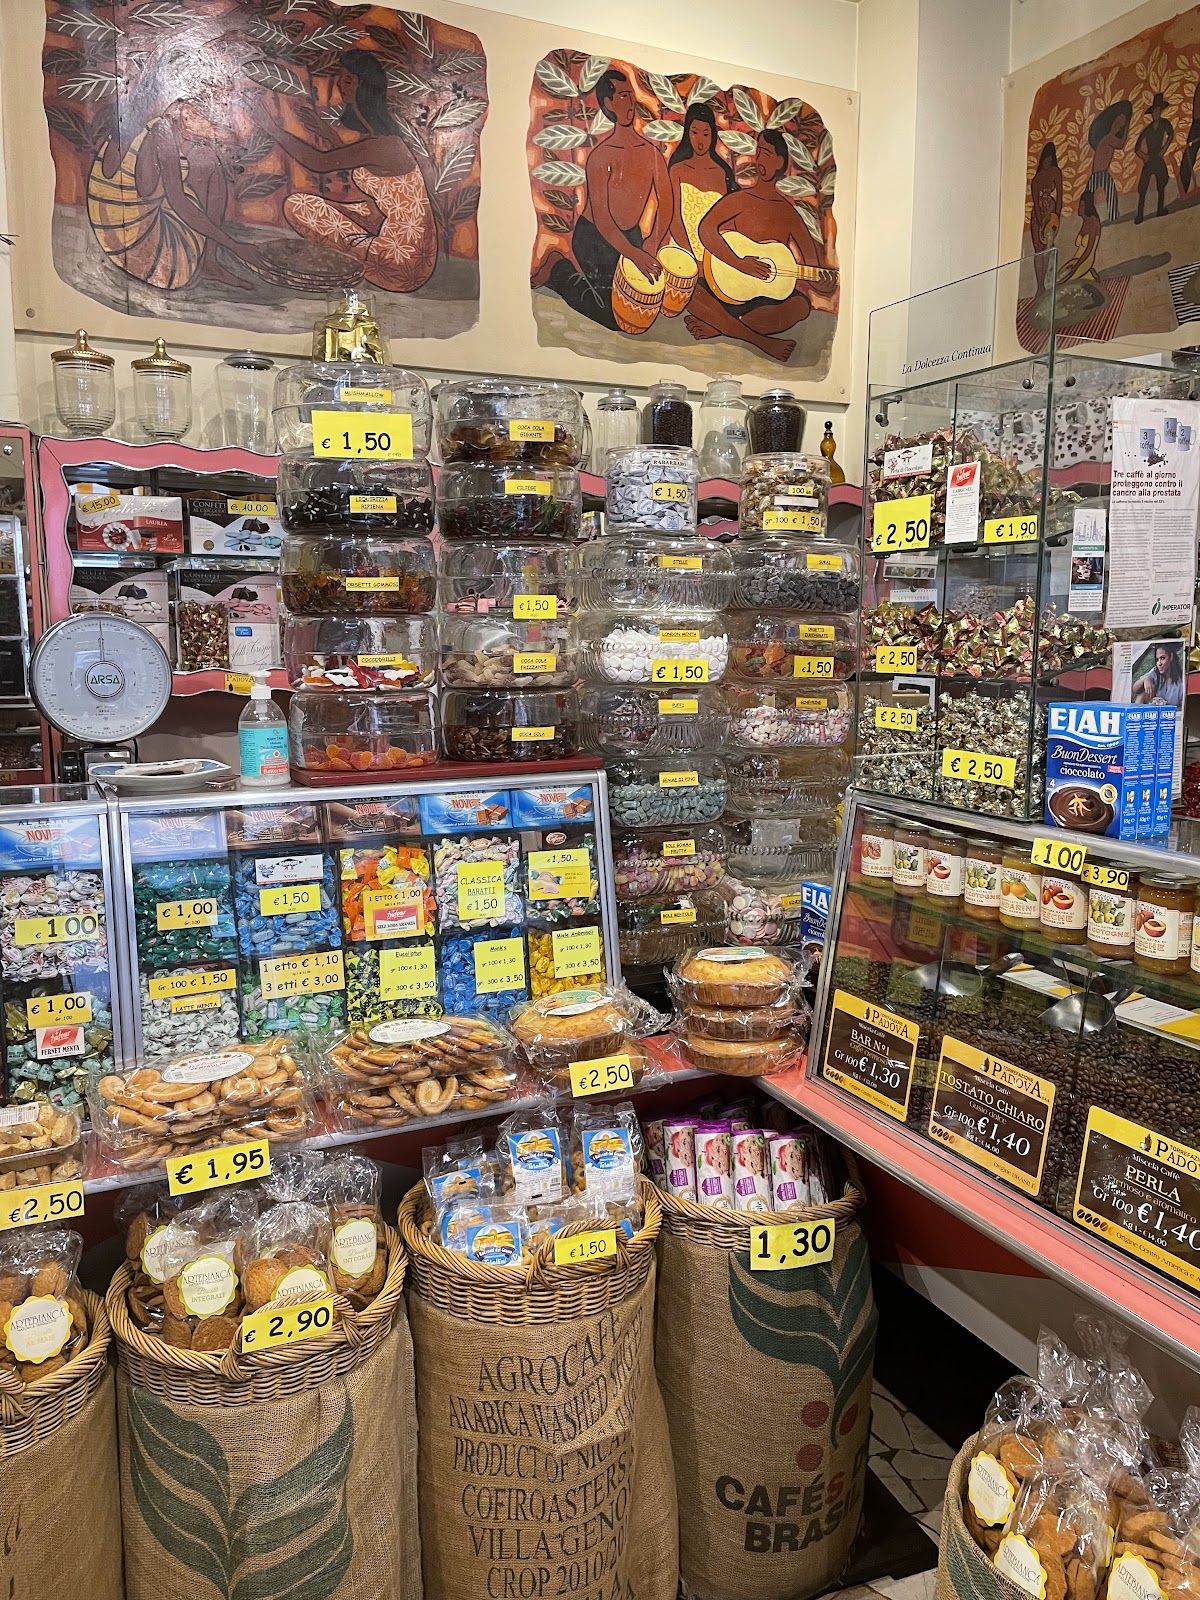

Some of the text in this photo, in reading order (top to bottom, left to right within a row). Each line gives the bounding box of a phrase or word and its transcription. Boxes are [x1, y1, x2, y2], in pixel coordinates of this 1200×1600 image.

[902, 343, 991, 375] La Dolcezza Continua
[321, 431, 391, 454] € 1,50
[1143, 431, 1148, 440] 3
[1112, 480, 1177, 489] proteggono contro
[1113, 470, 1177, 480] Tre caffè al giorno
[654, 487, 687, 500] € 1,50
[1112, 489, 1182, 498] cancro alla prostata
[145, 519, 168, 527] LAUREA
[996, 521, 1036, 539] € 1,90
[876, 534, 883, 546] €
[887, 519, 928, 548] 2,50
[1162, 603, 1191, 611] IMPERATOR
[880, 651, 915, 667] € 2,50
[90, 674, 120, 685] ARSA
[226, 673, 255, 683] PADOVA
[656, 665, 703, 681] € 1,50
[880, 711, 913, 726] € 2,50
[1050, 707, 1121, 736] ELAH
[951, 757, 1003, 780] € 2,50
[1060, 765, 1106, 780] cioccolato
[1049, 778, 1056, 788] 4
[460, 875, 502, 886] CLASSICA
[1083, 866, 1128, 886] € 3,90
[401, 889, 421, 900] 1,00
[162, 902, 213, 919] € 1,00
[1092, 927, 1130, 938] COTOGNE
[263, 955, 339, 973] 1 etto € 1,10
[190, 973, 228, 986] € 1,50
[265, 974, 339, 992] 3 etti € 3,00
[31, 995, 86, 1015] € 1,00
[175, 1002, 218, 1012] LATTE MENTA
[871, 1009, 909, 1039] PADOVA
[851, 1029, 872, 1047] BAR
[41, 1045, 80, 1056] FERNET MENTA
[834, 1049, 900, 1088] Gr 100 € 1,30
[991, 1060, 1042, 1099] PADOVA
[941, 1070, 994, 1106] TOSTATO
[996, 1099, 1045, 1131] CHIARO
[988, 1110, 1007, 1125] dolce
[943, 1104, 1031, 1156] Gr 100 € 1,40
[175, 1147, 265, 1185] € 1,95
[1132, 1153, 1181, 1181] Miscela Caffè
[1126, 1164, 1181, 1203] PERLA
[1093, 1186, 1109, 1202] Gr
[1111, 1196, 1134, 1216] 100
[1137, 1202, 1153, 1224] €
[1153, 1196, 1197, 1225] aromatico
[757, 1224, 831, 1264] 1,30
[1161, 1256, 1189, 1277] America
[182, 1267, 232, 1286] ARTEBIANCA
[191, 1292, 225, 1303] INTEGRALI
[10, 1306, 66, 1331] ARTEBIANCA
[244, 1306, 330, 1343] € 2,90
[450, 1375, 608, 1445] ARABICA WASHED
[453, 1435, 568, 1485] PRODUCT OF
[974, 1461, 1010, 1500] ARTEBIANCA
[715, 1470, 846, 1518] CAFÉS
[467, 1524, 553, 1560] VILLA
[486, 1566, 551, 1600] CROP
